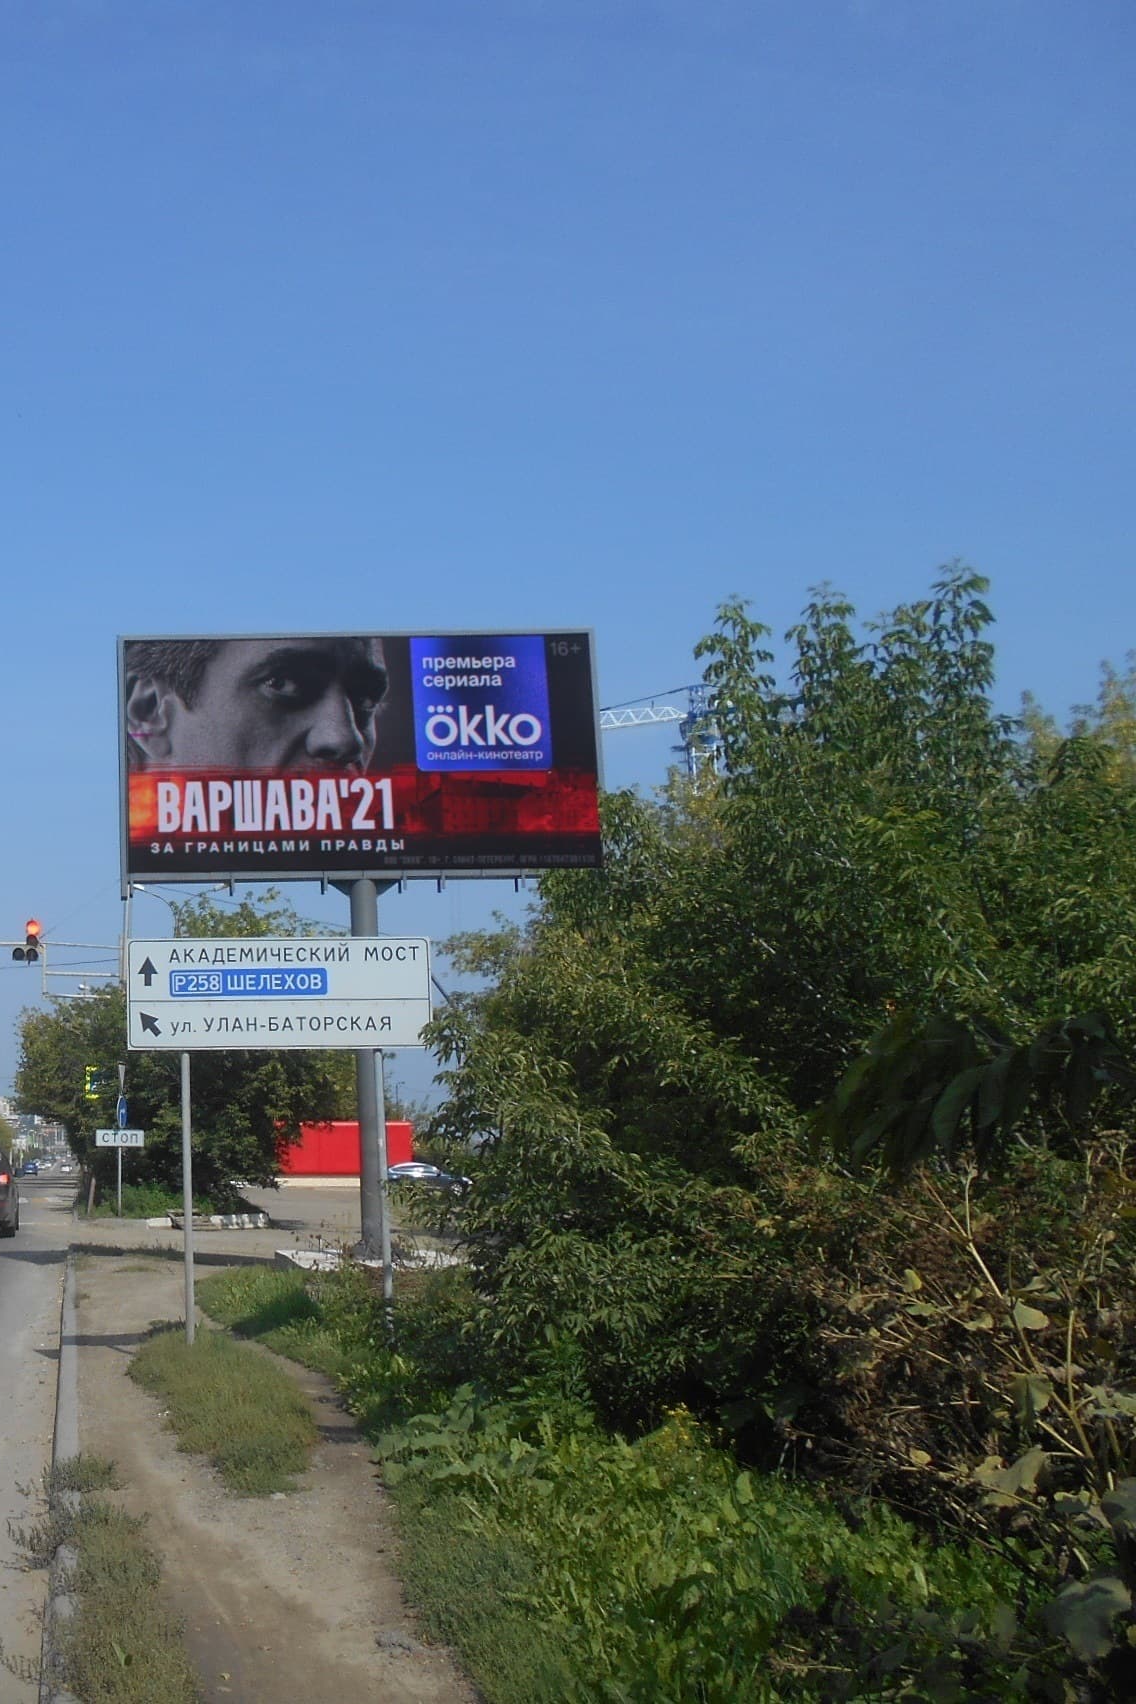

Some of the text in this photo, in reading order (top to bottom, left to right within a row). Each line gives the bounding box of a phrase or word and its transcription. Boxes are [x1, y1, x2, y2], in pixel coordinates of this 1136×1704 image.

[550, 640, 582, 657] 16+
[422, 655, 516, 672] премьера
[423, 674, 503, 691] сериала
[427, 749, 544, 761] онлайн-кинотеатр
[156, 778, 395, 833] ВАРШАВА'21
[150, 838, 405, 854] ЗА ГРАНИЦАМИ ПРАВДЫ
[169, 943, 420, 965] АКАДЕМИЧЕСКИЙ МОСТ
[175, 972, 323, 992] Р258 ШЕЛЕХОВ
[170, 1015, 393, 1036] ул. УЛАН-БАТОРСКАЯ
[101, 1132, 139, 1145] СТОП
